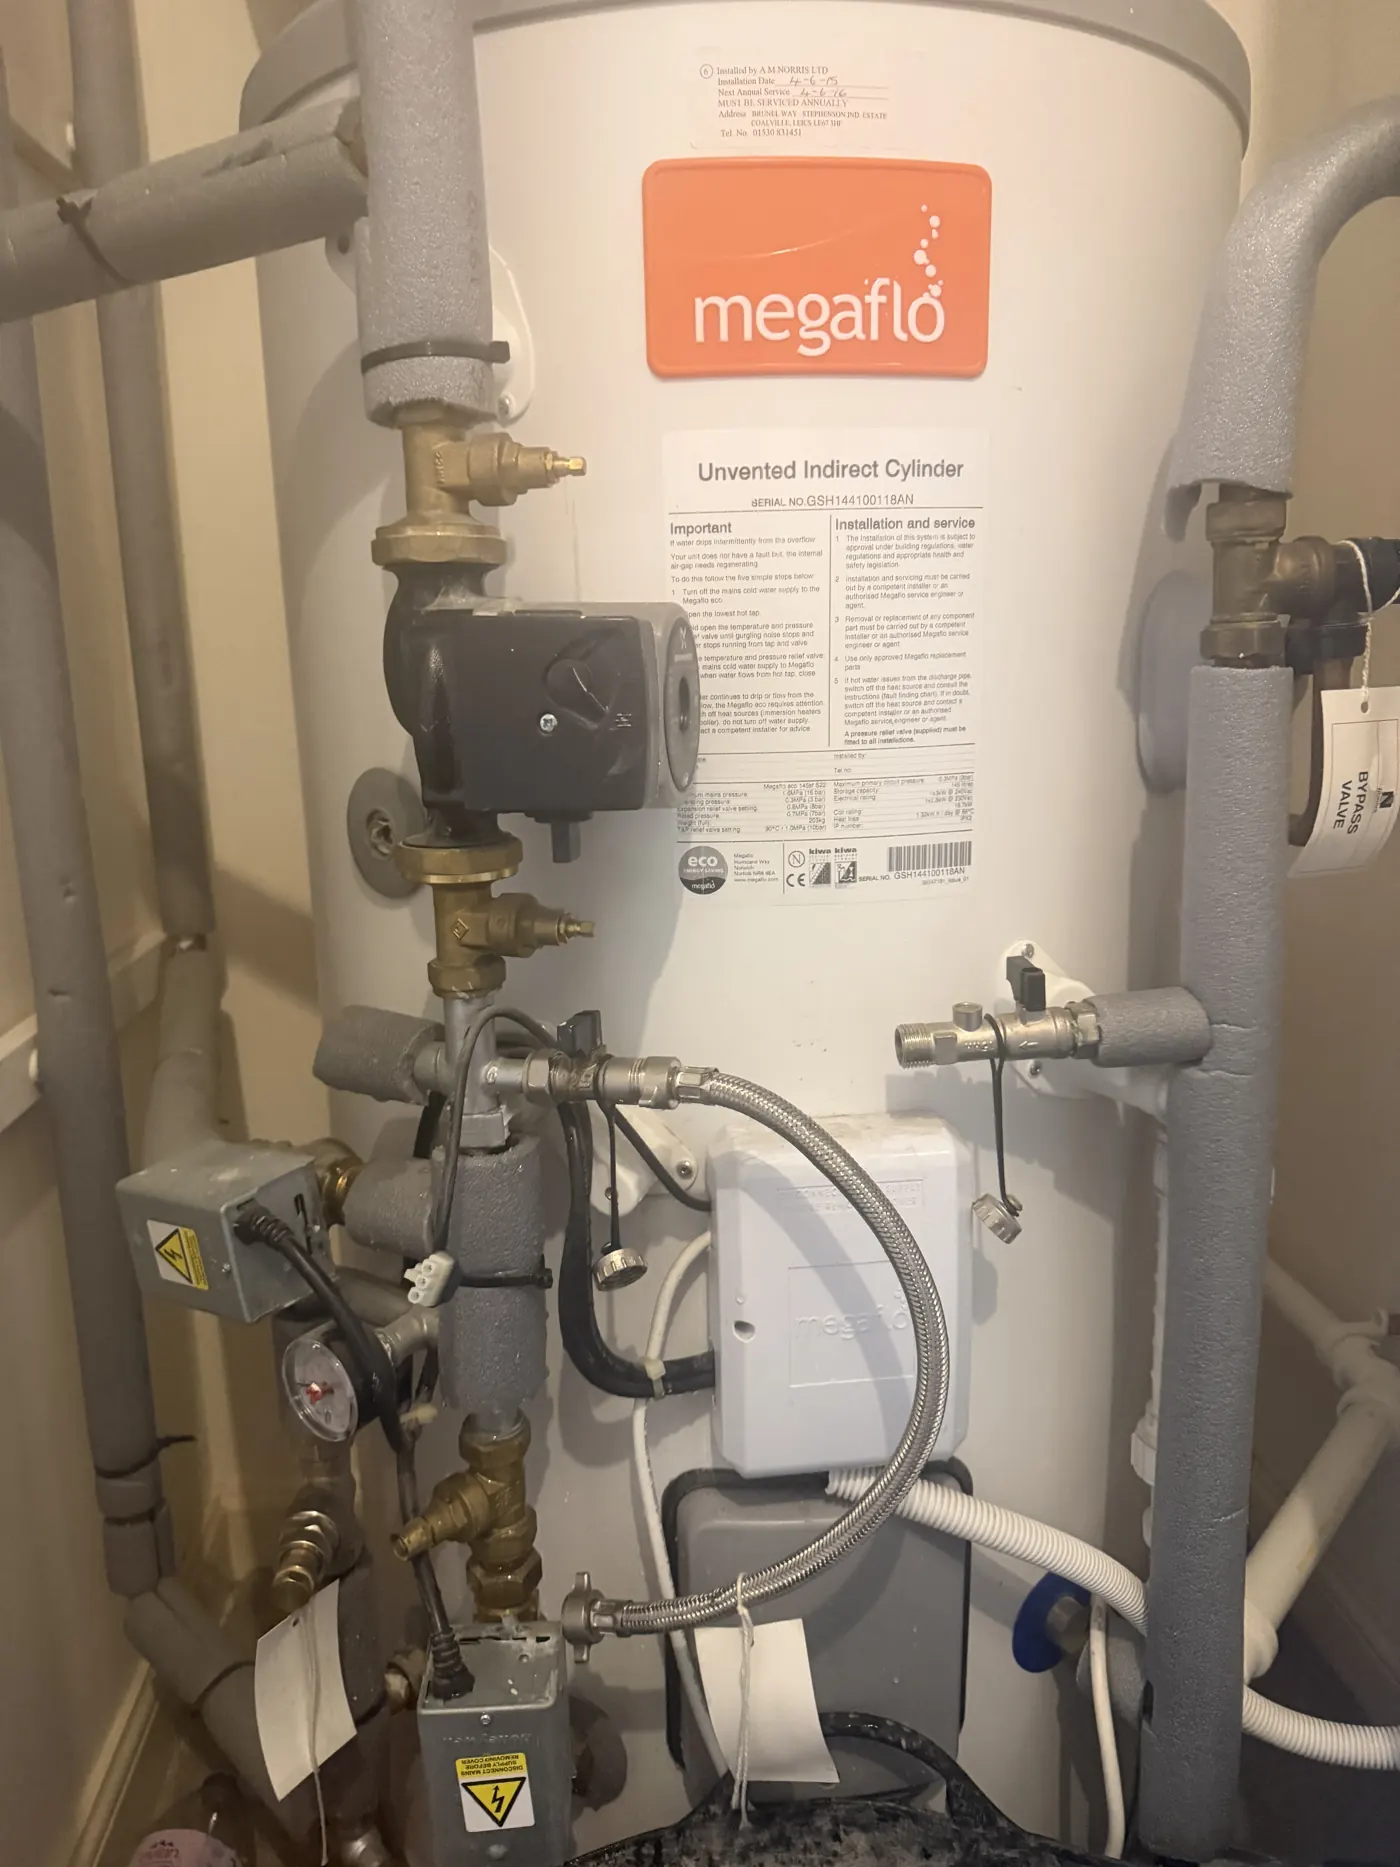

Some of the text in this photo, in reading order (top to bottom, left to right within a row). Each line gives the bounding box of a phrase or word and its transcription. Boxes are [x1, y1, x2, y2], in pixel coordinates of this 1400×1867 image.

[717, 66, 747, 75] Installed
[748, 66, 758, 76] by
[777, 66, 809, 74] NORRIS
[718, 77, 756, 85] Installation
[764, 88, 790, 96] Service
[718, 99, 741, 107] MUST
[801, 99, 848, 107] ANNUALLY
[694, 277, 945, 357] megaflo
[699, 459, 964, 482] Unvented Indirect Cylinder
[752, 498, 787, 507] SERIAL
[836, 517, 975, 530] Installation and service
[670, 522, 732, 536] Important
[714, 538, 756, 546] intermittently
[788, 536, 815, 544] overflow
[751, 574, 772, 582] simple
[778, 586, 799, 594] supply
[730, 623, 769, 631] temperature
[785, 622, 813, 630] pressure
[736, 632, 761, 640] gurgling
[1333, 780, 1352, 829] VALVE
[1347, 771, 1368, 834] BYPASS
[688, 856, 718, 867] eco
[483, 1765, 523, 1774] DISCONNECT
